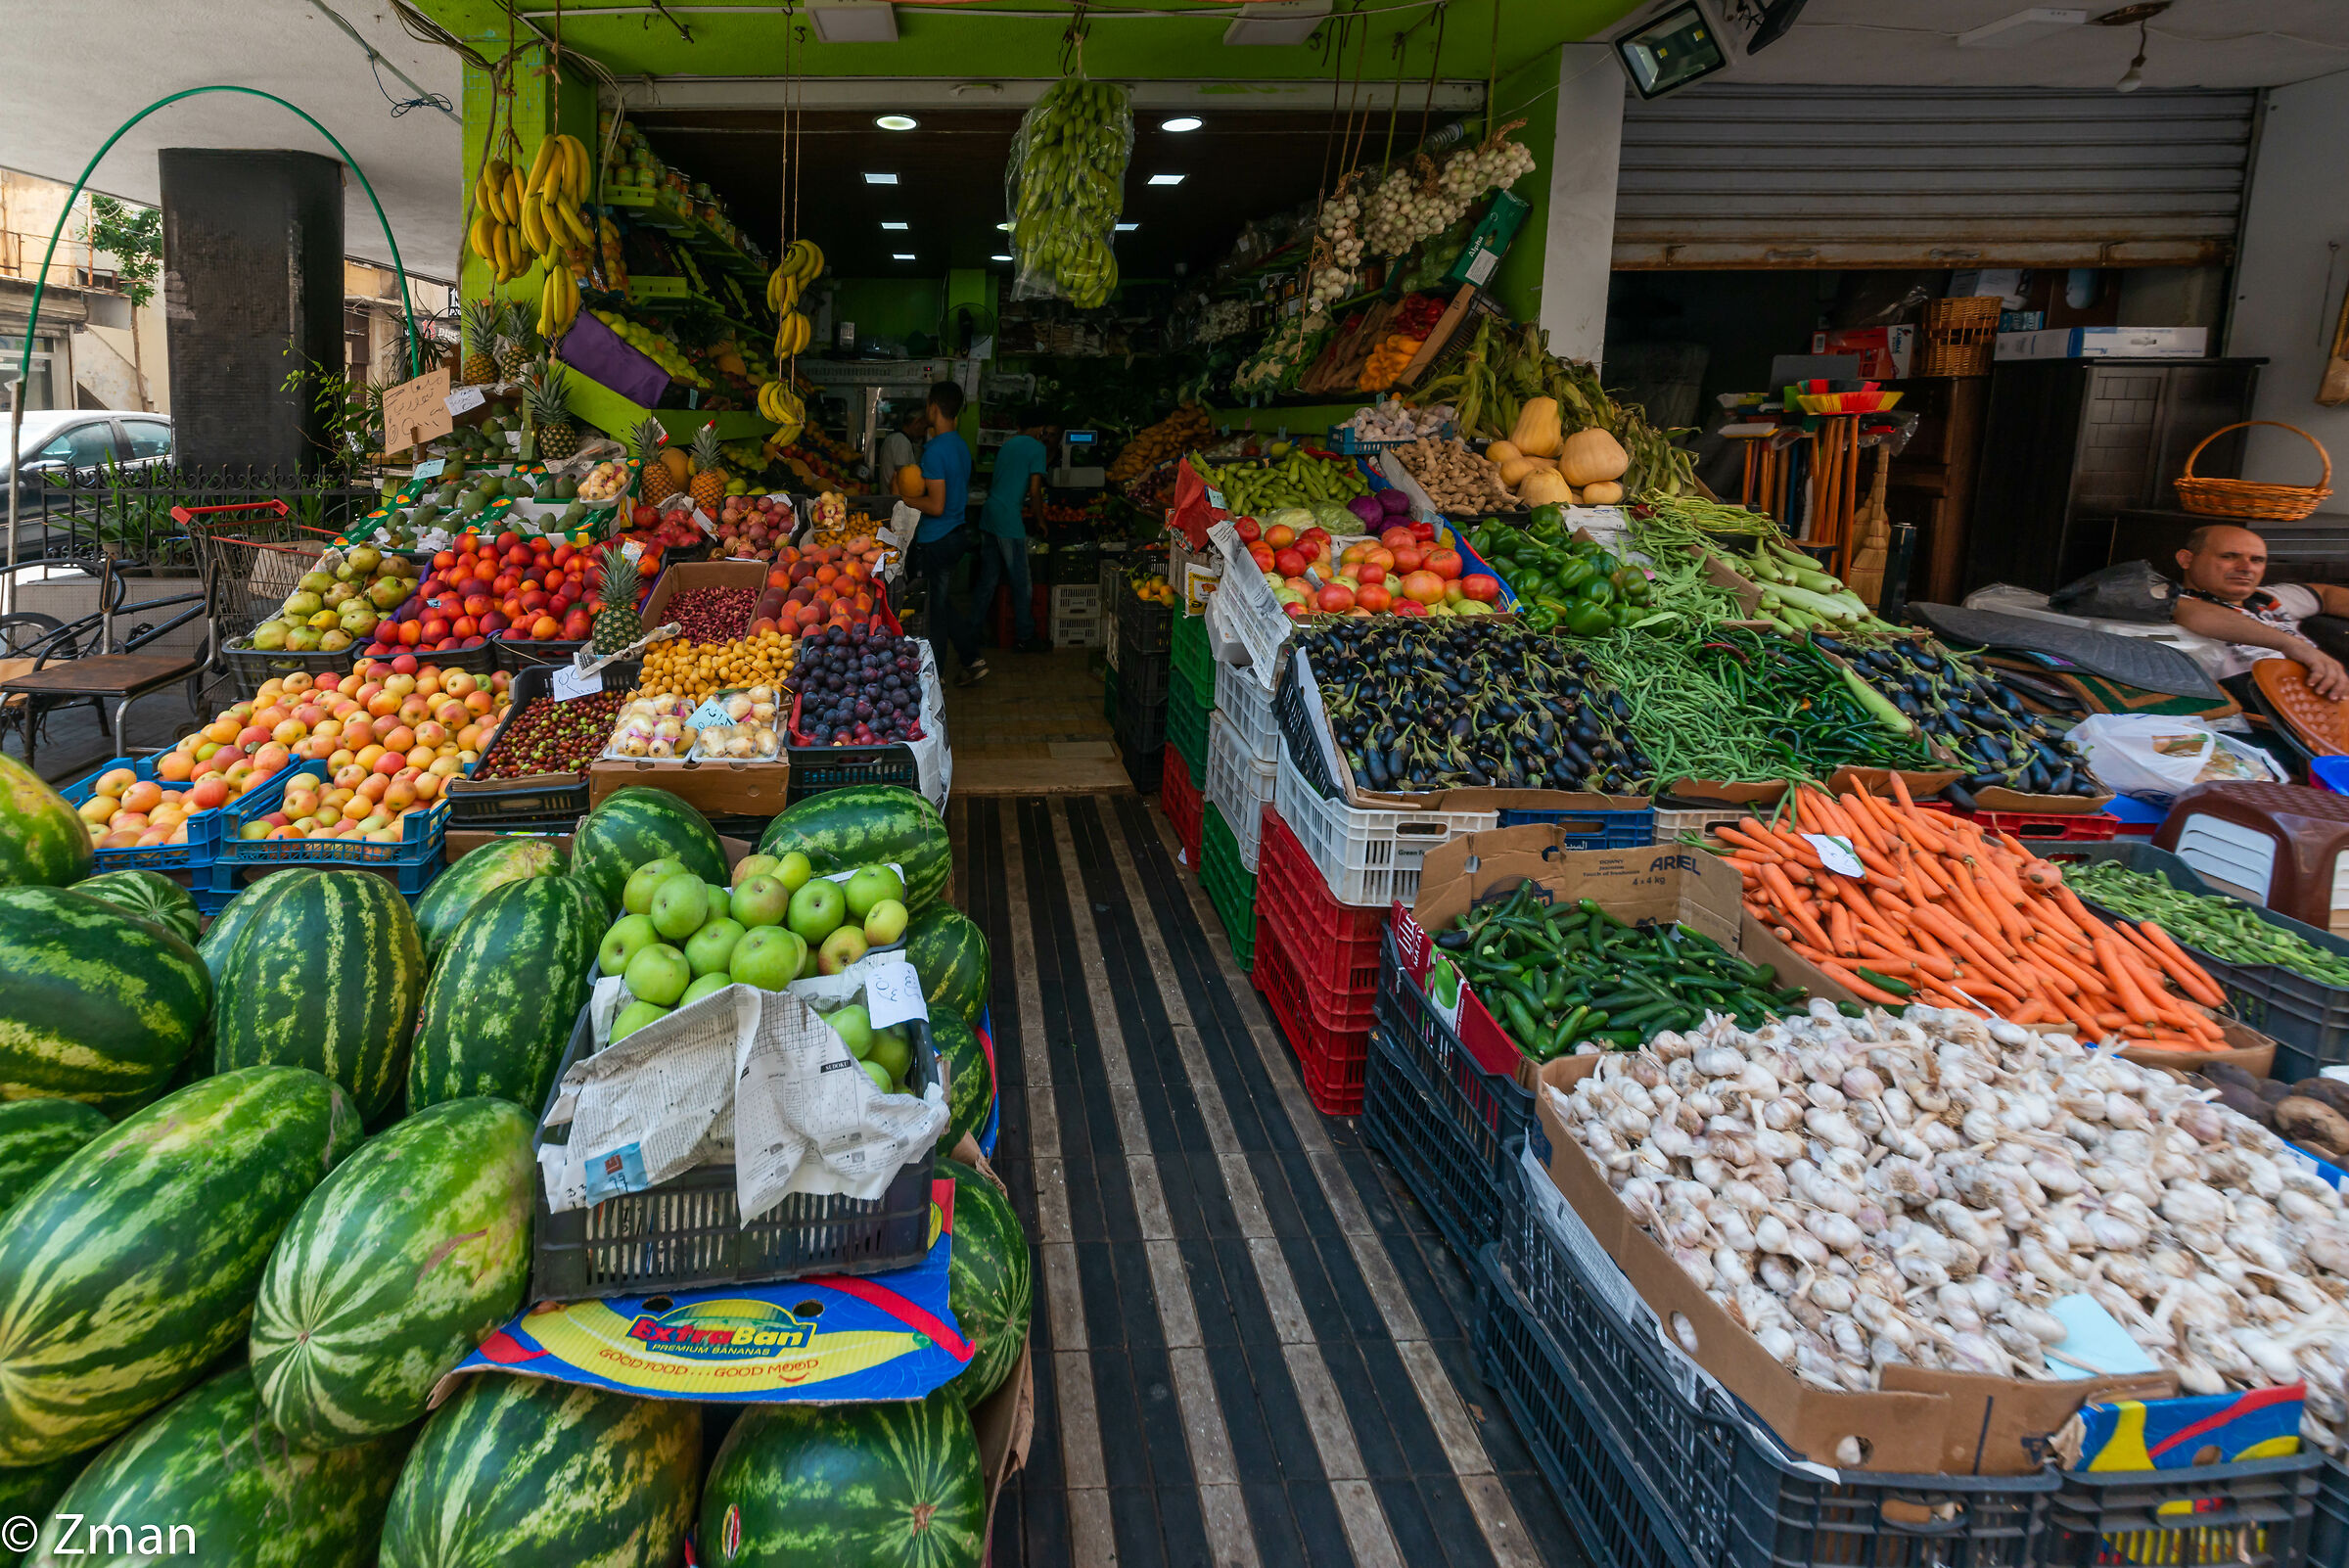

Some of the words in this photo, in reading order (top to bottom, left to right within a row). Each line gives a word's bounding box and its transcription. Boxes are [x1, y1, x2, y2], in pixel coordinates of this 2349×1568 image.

[1468, 235, 1484, 257] Alpha
[1649, 854, 1701, 876] ARIEL
[1654, 876, 1666, 886] kg
[631, 1318, 804, 1347] ExtraBan
[652, 1343, 710, 1355] PREMIUM
[712, 1347, 770, 1356] BANANAS
[599, 1348, 643, 1369] GOOD
[714, 1365, 763, 1377] GOOD
[767, 1359, 819, 1375] MOOD
